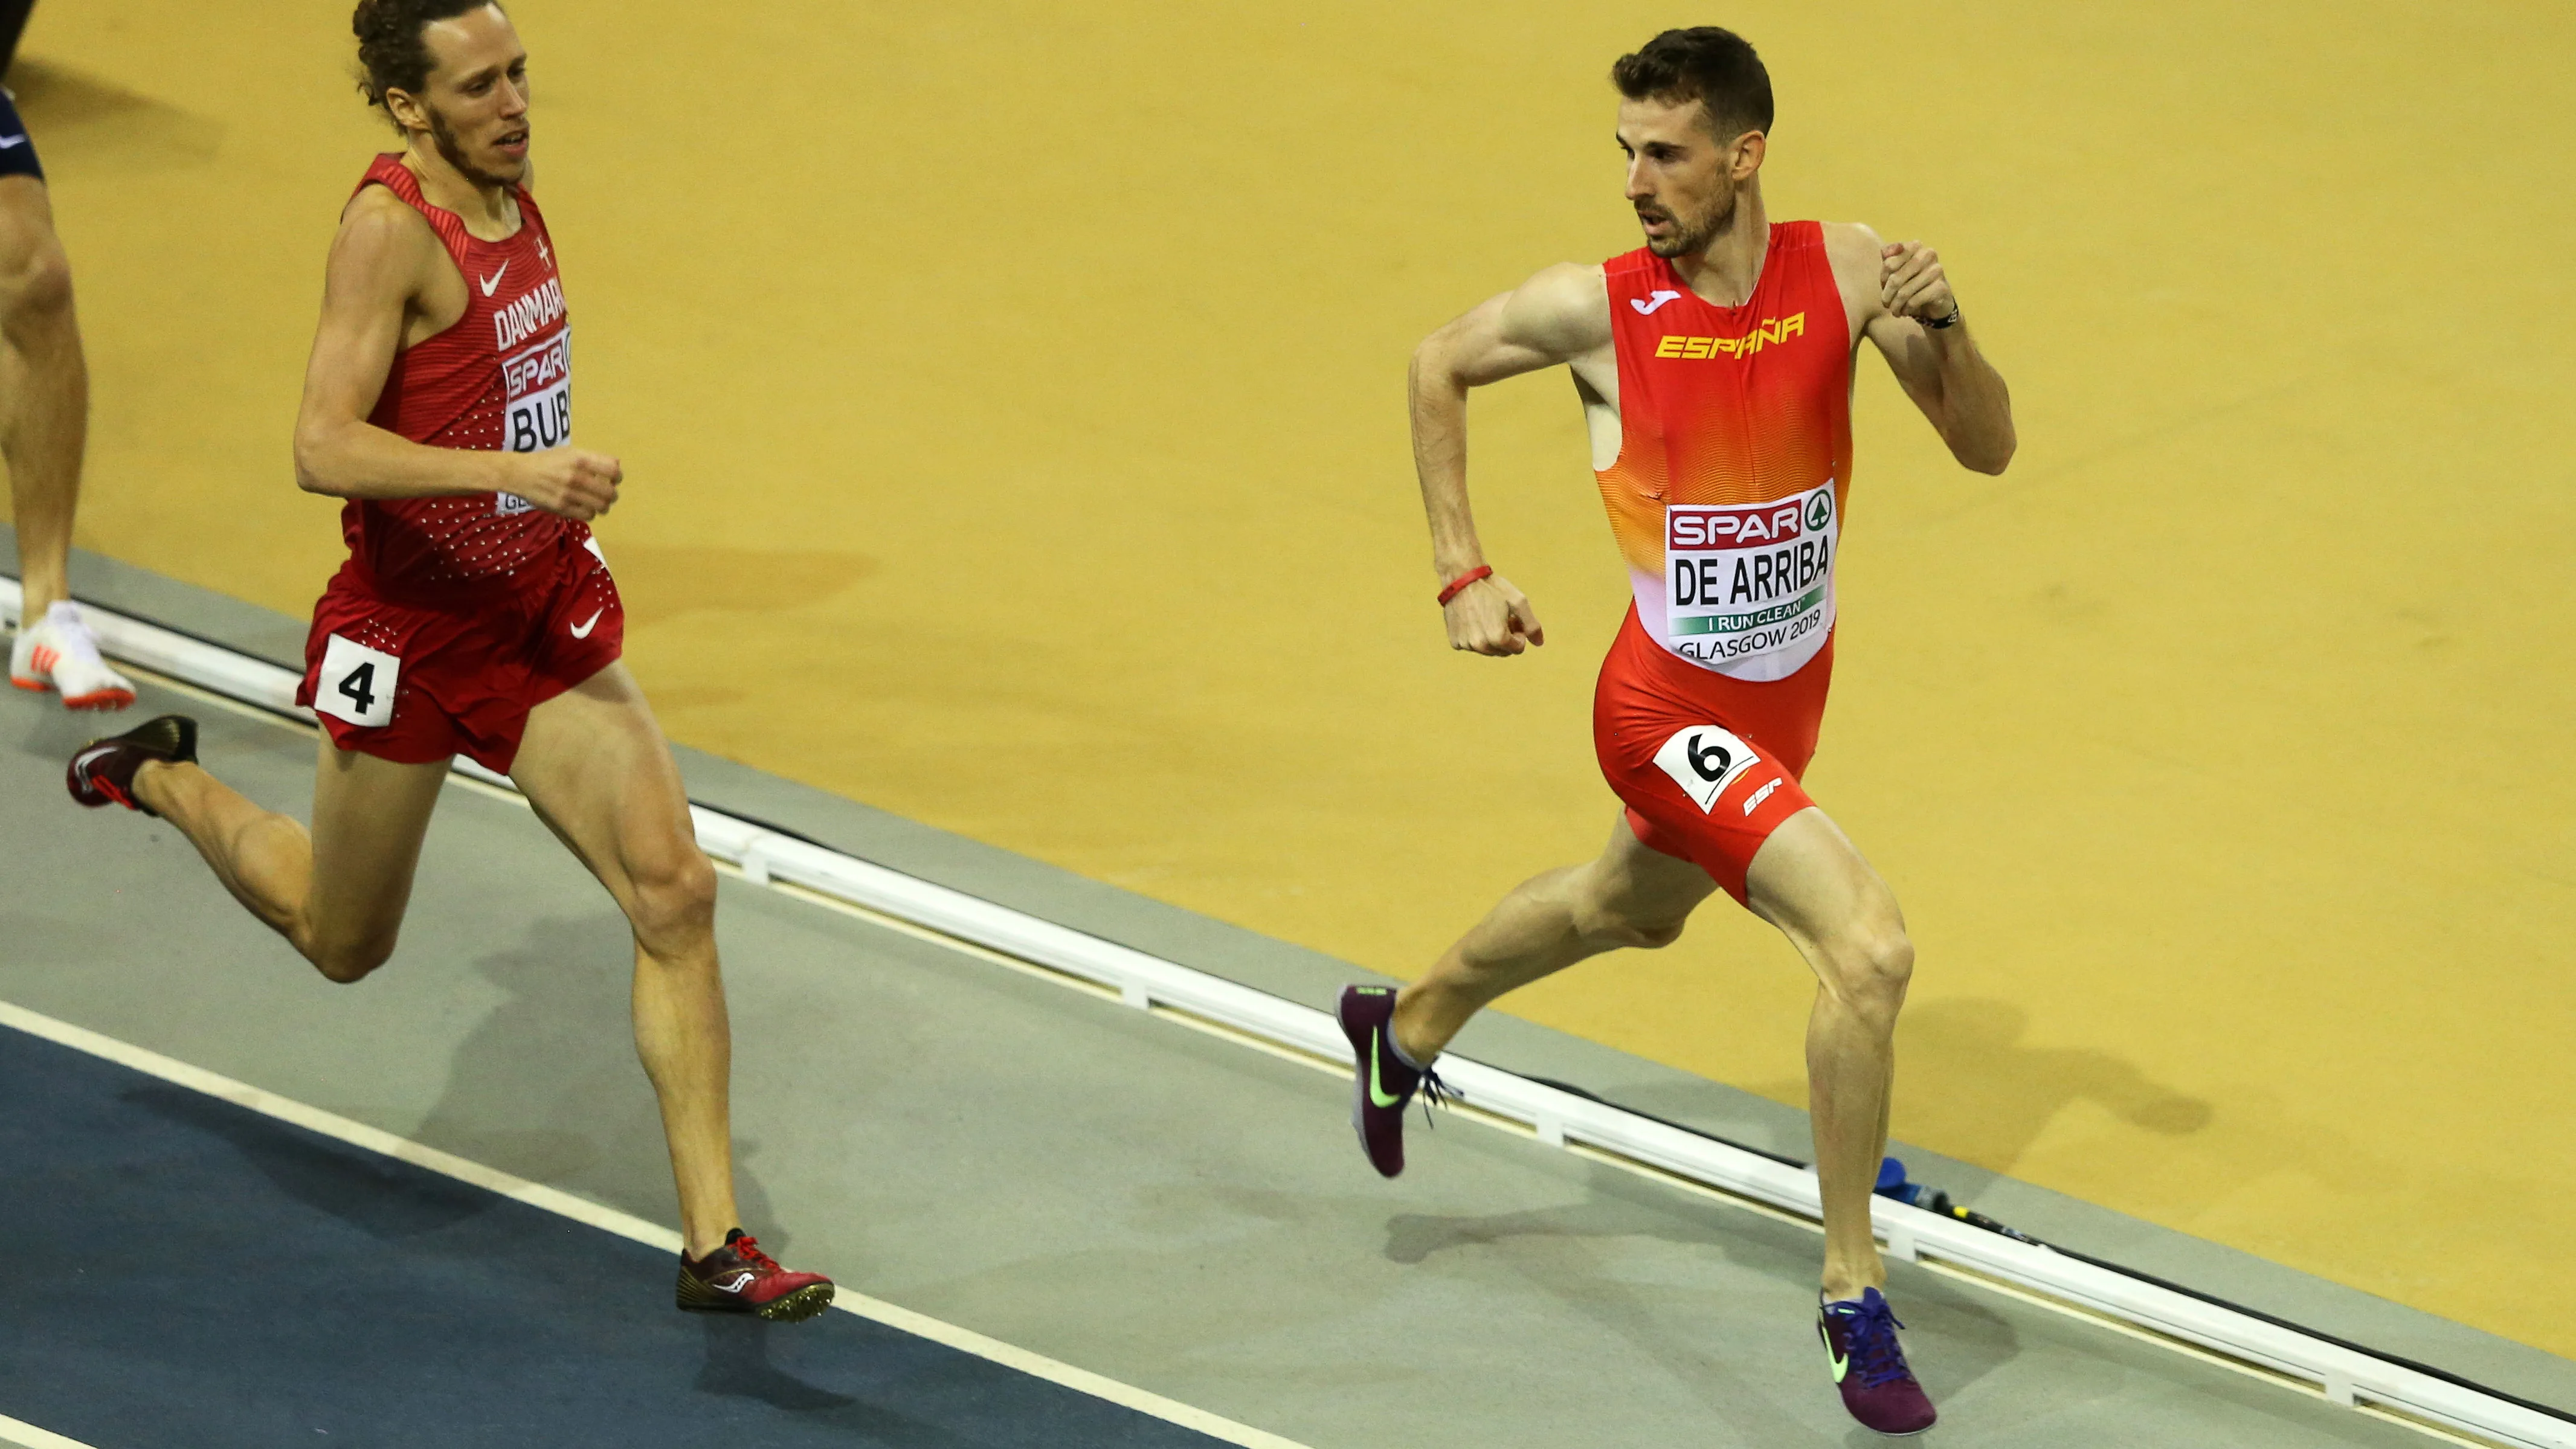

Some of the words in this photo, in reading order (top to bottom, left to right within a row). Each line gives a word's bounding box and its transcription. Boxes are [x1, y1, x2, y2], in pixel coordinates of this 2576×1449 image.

[494, 276, 567, 352] DANMAR
[1655, 312, 1805, 360] ESPAÑA
[509, 346, 565, 398] SPAR
[513, 384, 571, 453] BUB
[1673, 507, 1799, 545] SPAR
[1675, 559, 1719, 606] DE
[1730, 535, 1829, 605] ARRIBA
[1679, 626, 1788, 660] GLASGOW
[1790, 609, 1821, 640] 2019
[1708, 617, 1714, 632] I
[1718, 613, 1753, 631] RUN
[1757, 600, 1802, 624] CLEAN
[338, 662, 375, 715] 4
[1687, 733, 1731, 782] 6
[1743, 777, 1783, 817] ESP
